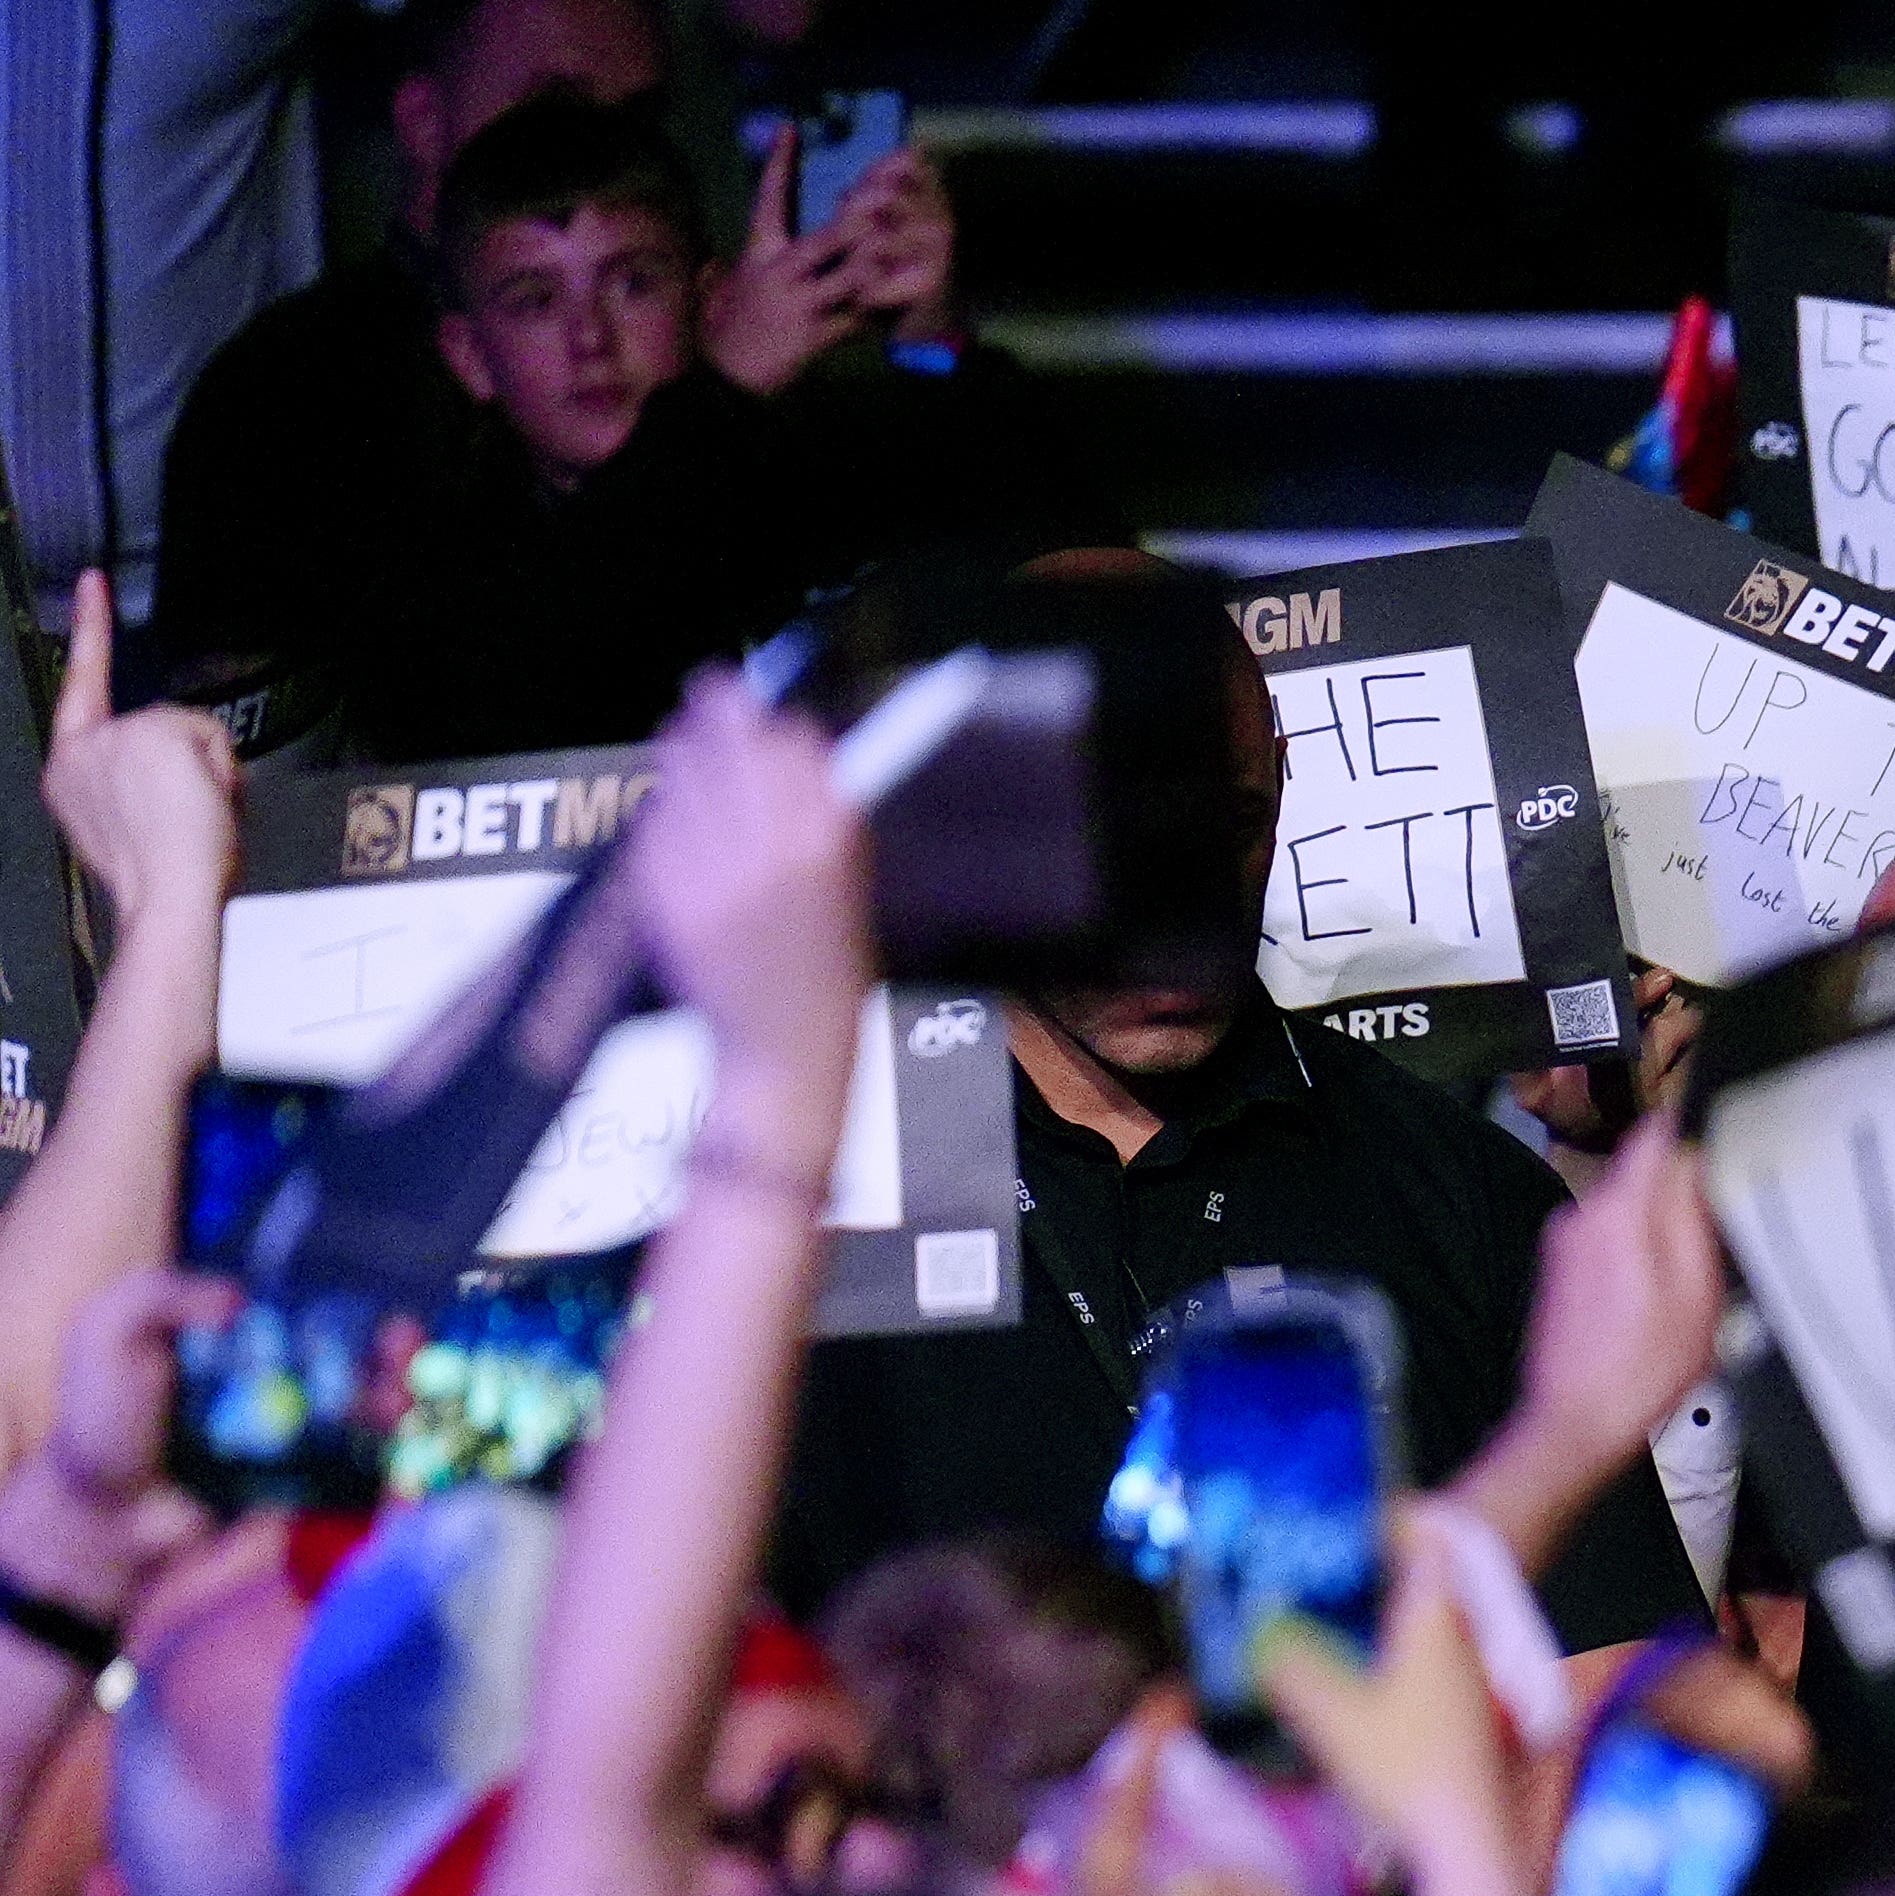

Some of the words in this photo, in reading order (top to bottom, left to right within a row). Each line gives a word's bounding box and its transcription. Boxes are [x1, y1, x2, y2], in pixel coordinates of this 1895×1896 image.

[1224, 588, 1341, 655] GM
[1694, 644, 1808, 750] UP
[1519, 790, 1577, 826] PDC
[1262, 803, 1494, 945] ETT
[1661, 841, 1708, 880] just
[1742, 872, 1783, 913] lost
[1808, 900, 1841, 931] the
[1203, 1190, 1225, 1222] EPS
[1068, 1290, 1095, 1325] EPS
